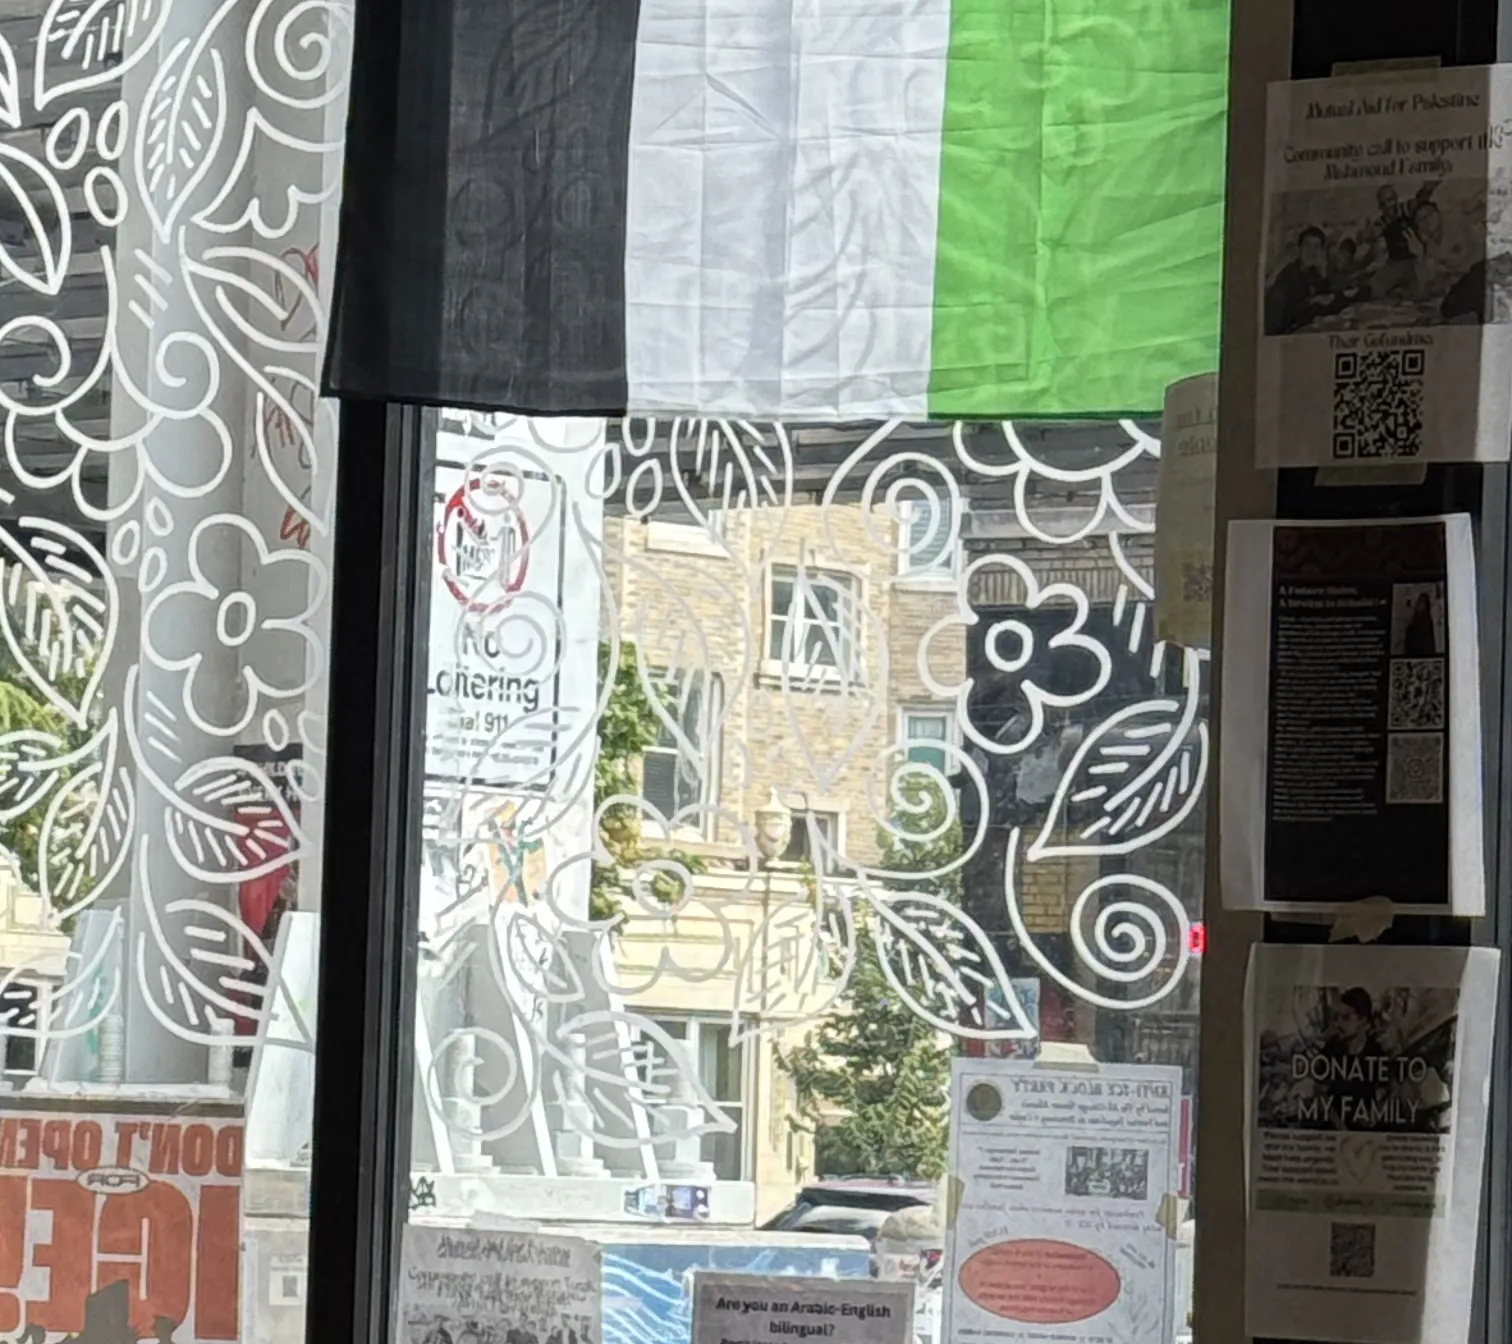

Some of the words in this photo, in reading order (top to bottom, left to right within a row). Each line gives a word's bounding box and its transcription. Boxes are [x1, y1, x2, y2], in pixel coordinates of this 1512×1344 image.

[1357, 98, 1382, 116] Aid
[1385, 98, 1406, 112] for
[1413, 93, 1481, 111] Palestine
[1284, 144, 1362, 163] Community
[1367, 139, 1391, 155] call
[1396, 138, 1411, 153] to
[1415, 134, 1473, 155] support
[427, 669, 540, 712] oitering
[484, 712, 510, 734] 911
[1291, 1053, 1389, 1082] DONATE
[1396, 1056, 1427, 1082] TO
[1296, 1095, 1335, 1122] MY
[1341, 1096, 1420, 1124] FAMILY
[715, 1297, 741, 1311] Are
[741, 1300, 768, 1314] you
[771, 1301, 789, 1313] an
[790, 1300, 891, 1320] Arabic-English
[769, 1320, 836, 1338] bilingual?
